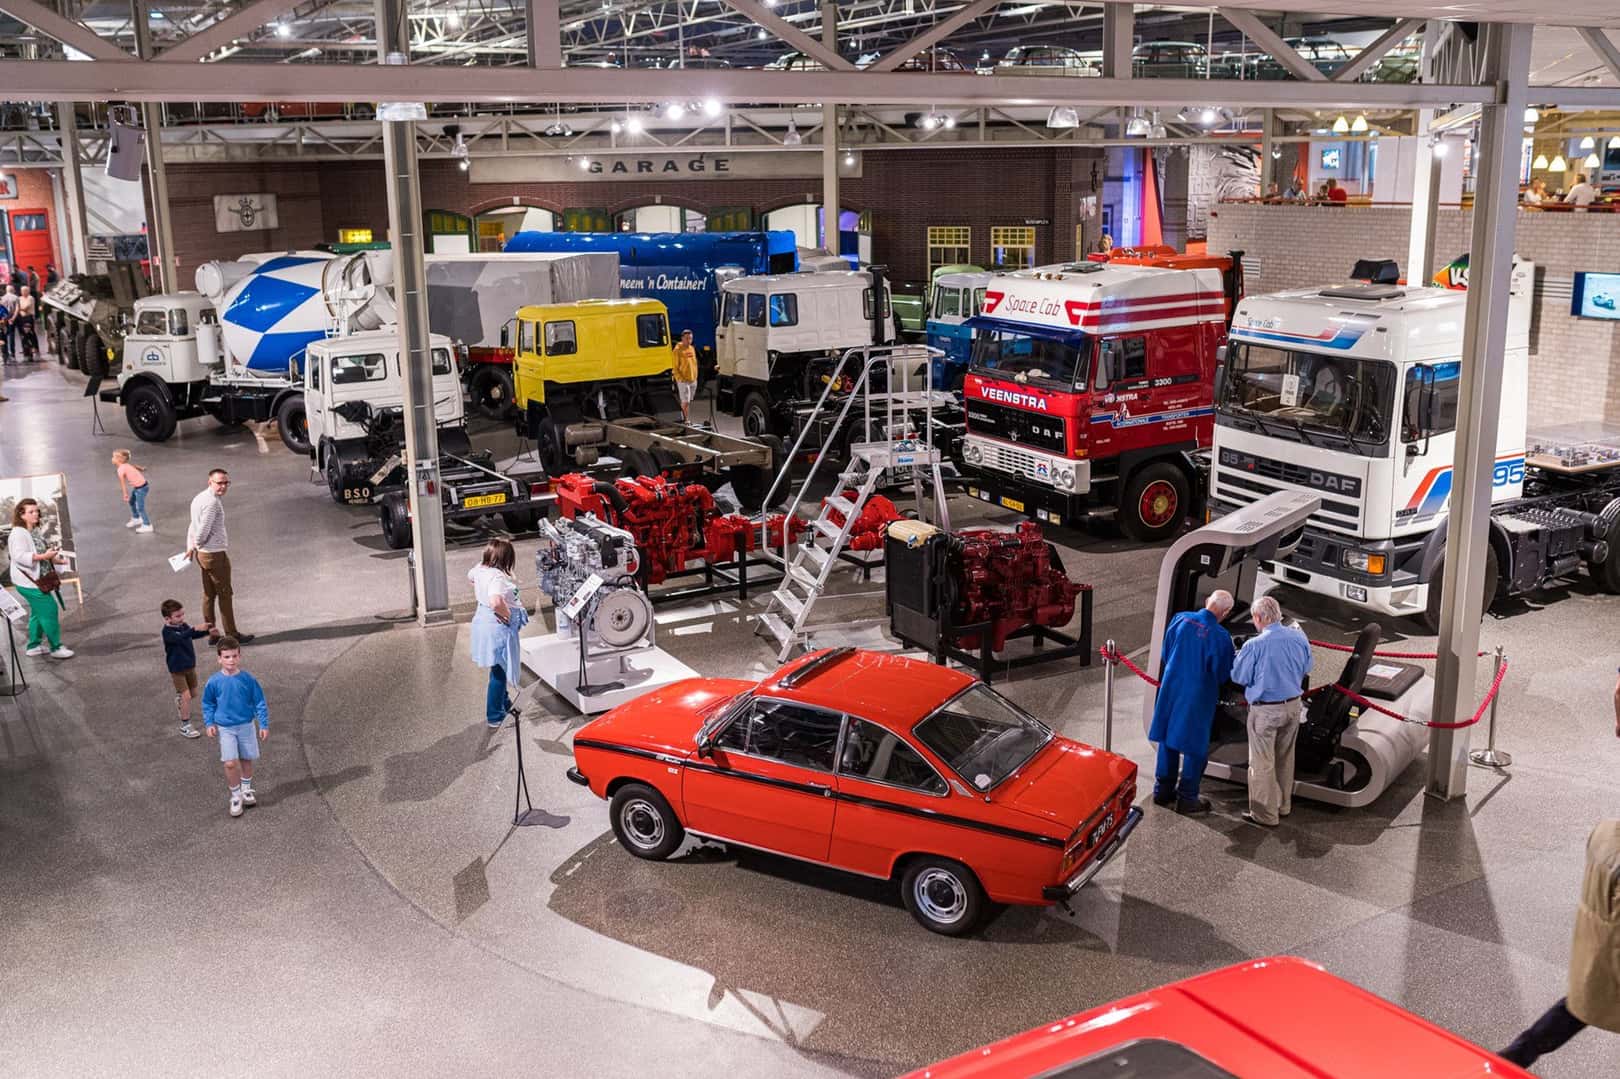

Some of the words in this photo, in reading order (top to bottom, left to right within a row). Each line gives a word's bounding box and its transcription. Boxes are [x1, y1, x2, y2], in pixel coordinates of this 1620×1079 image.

[589, 159, 730, 174] GARAGE
[619, 279, 645, 290] neem
[647, 275, 656, 290] 'n
[656, 273, 708, 291] Container!
[1005, 294, 1038, 315] Space
[1039, 297, 1061, 317] Cab
[980, 386, 1048, 411] VEENSTRA
[1031, 425, 1064, 440] DAF
[1221, 450, 1239, 465] 95
[1310, 471, 1357, 493] DAF
[1492, 463, 1526, 487] 95
